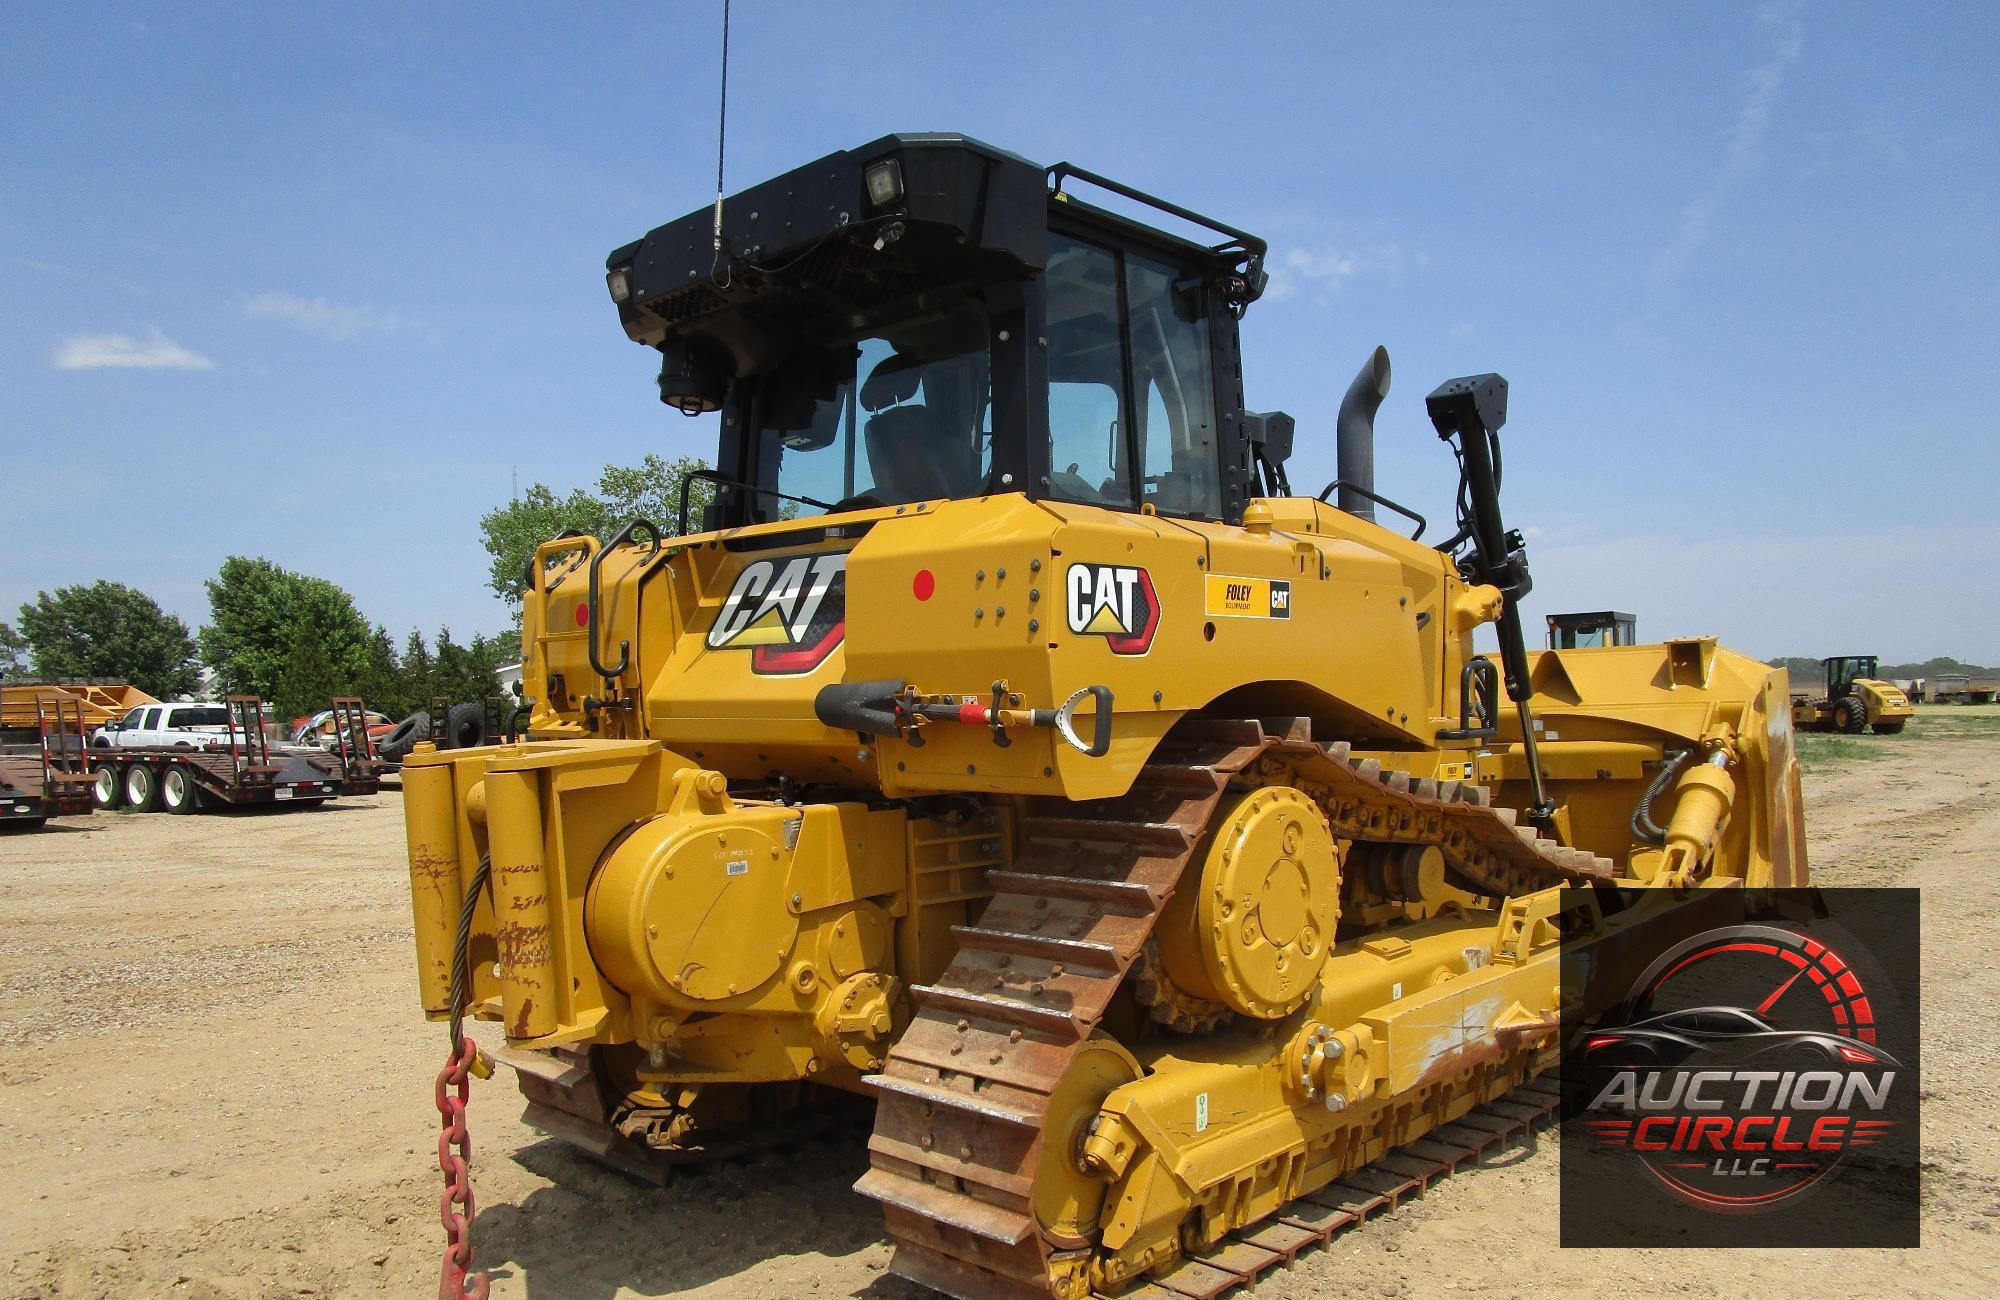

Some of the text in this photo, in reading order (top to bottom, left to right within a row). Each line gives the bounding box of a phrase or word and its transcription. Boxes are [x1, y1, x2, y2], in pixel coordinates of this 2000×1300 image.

[708, 553, 848, 647] CAT
[1067, 564, 1138, 633] CAT
[1226, 584, 1252, 601] FOLEY
[1271, 590, 1289, 609] CAT
[1225, 602, 1251, 610] EQUIPMENT
